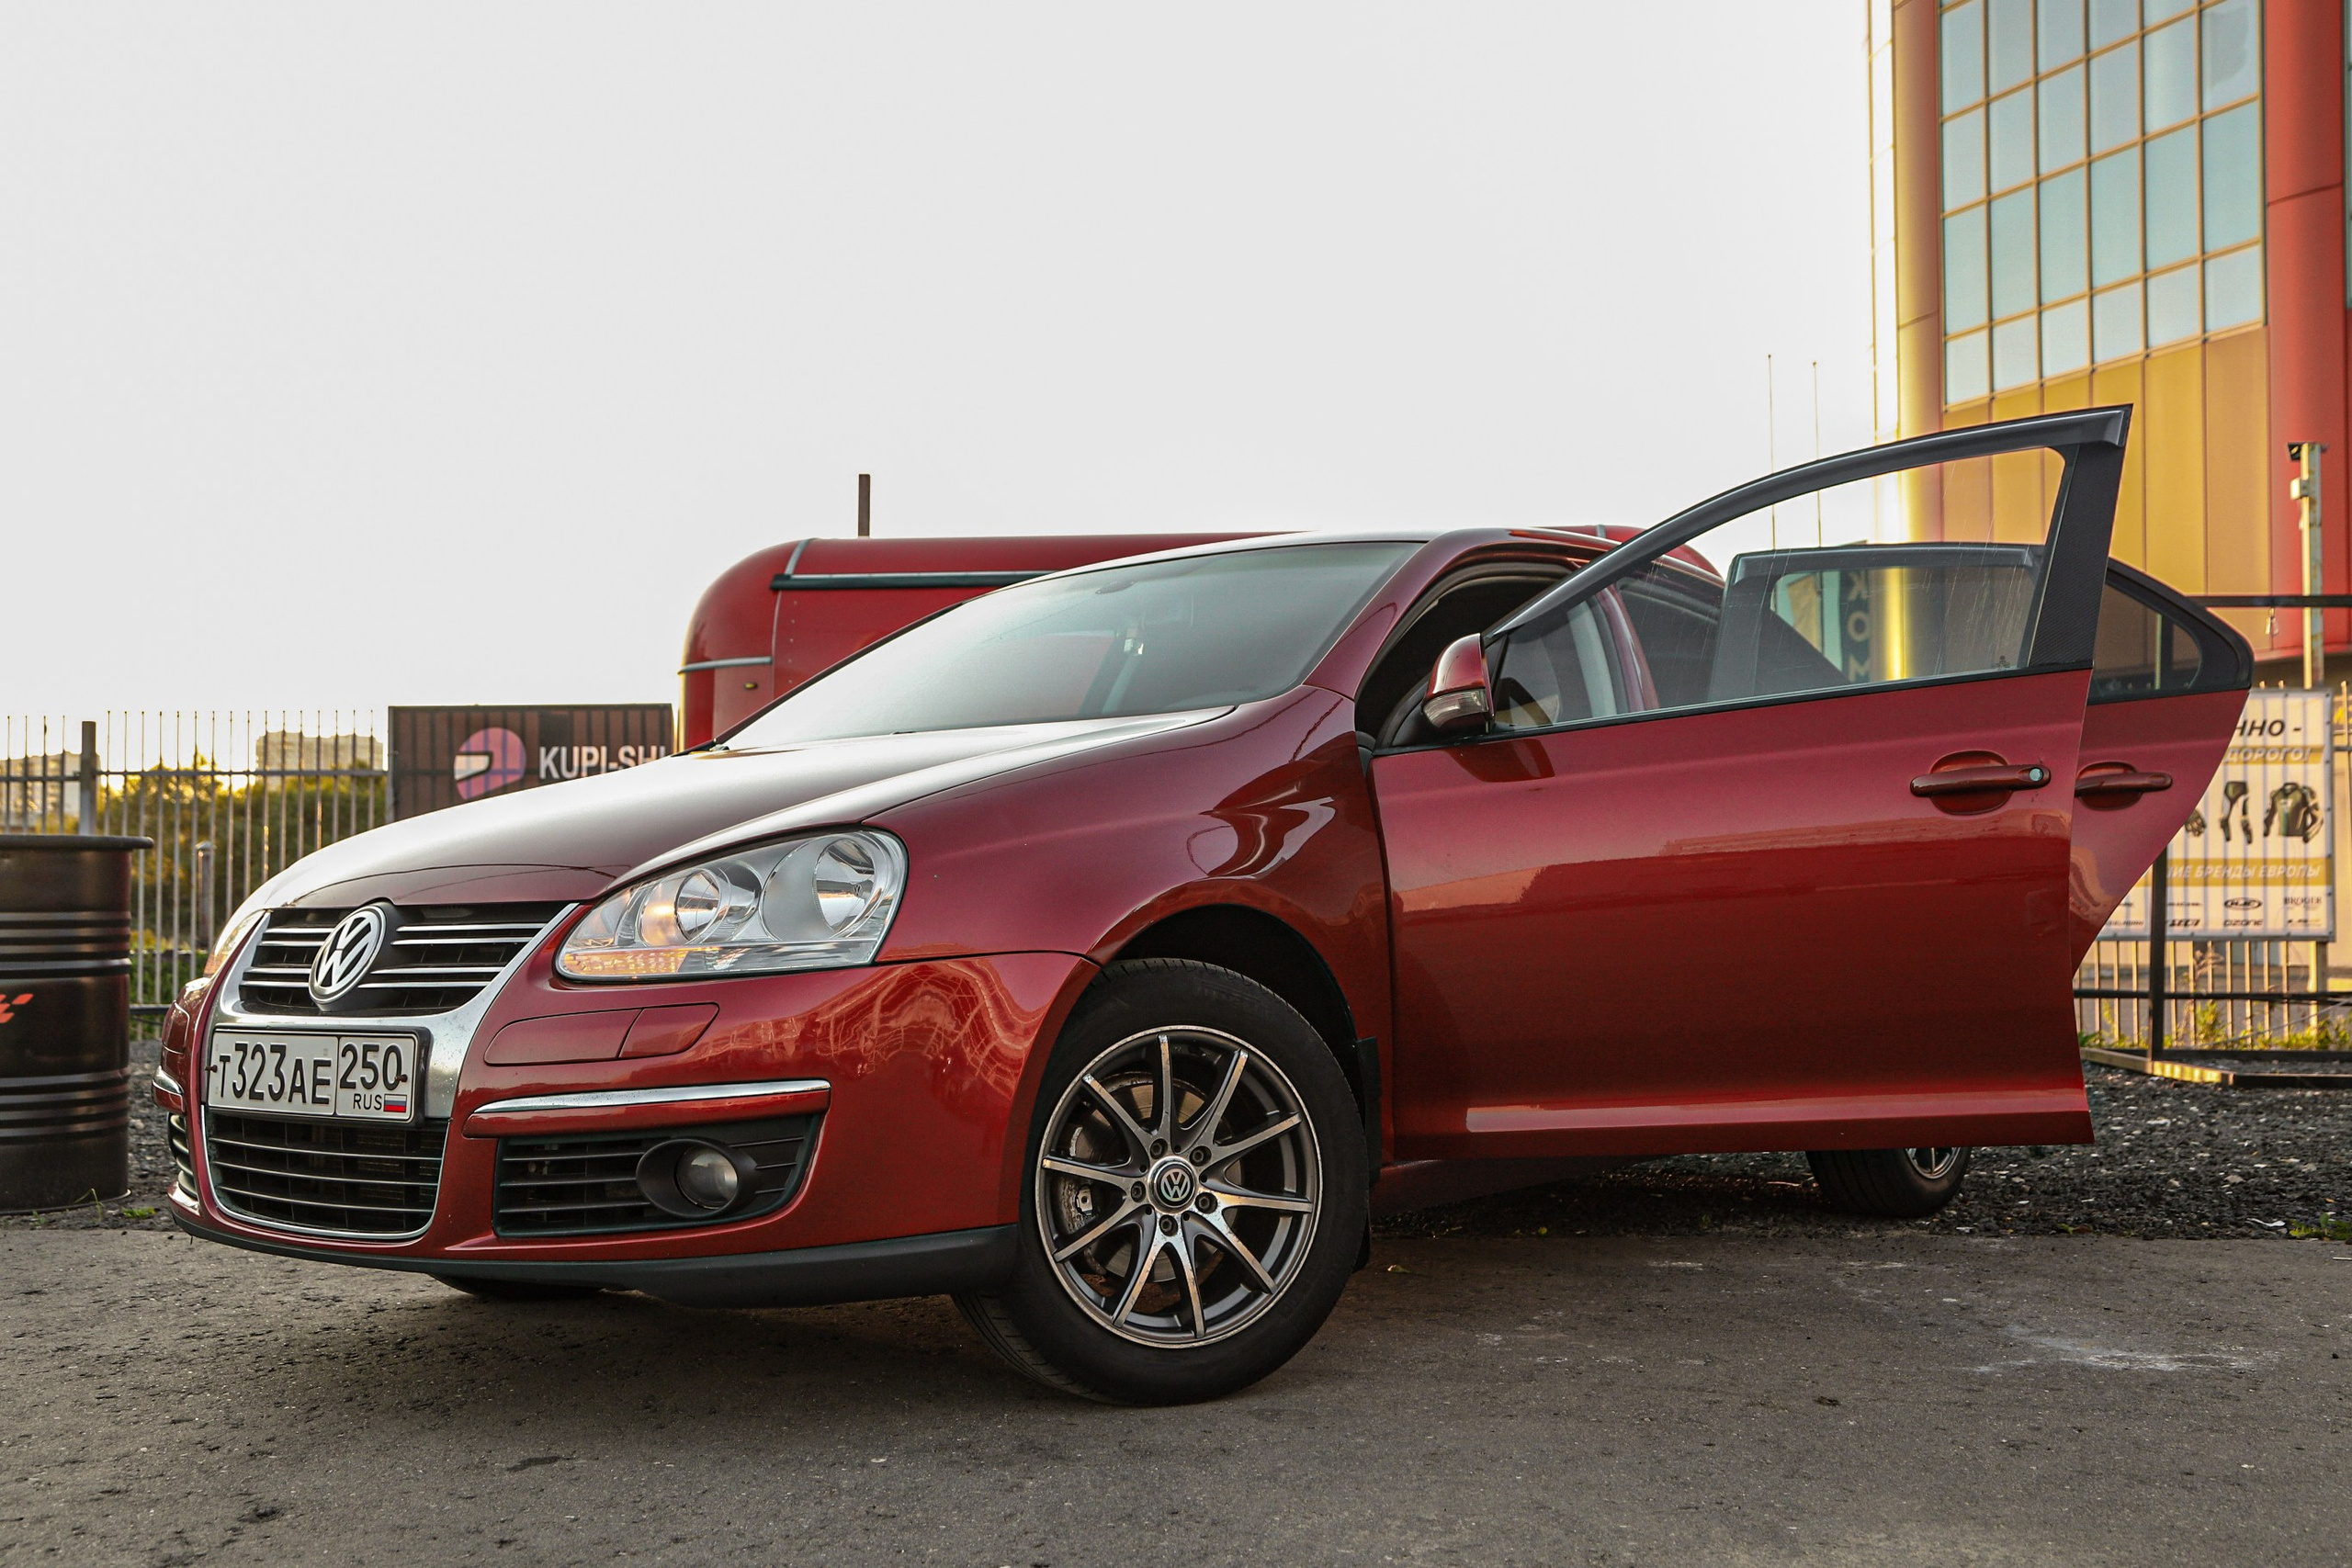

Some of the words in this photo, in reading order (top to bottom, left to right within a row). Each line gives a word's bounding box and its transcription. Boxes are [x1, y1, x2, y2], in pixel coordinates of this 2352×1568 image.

[2224, 747, 2312, 763] ДОРОГО!
[2195, 865, 2255, 880] БРЕНДЫ
[2259, 864, 2322, 878] ЕВРОПЫ
[339, 1043, 402, 1090] 250
[354, 1093, 382, 1111] RUS
